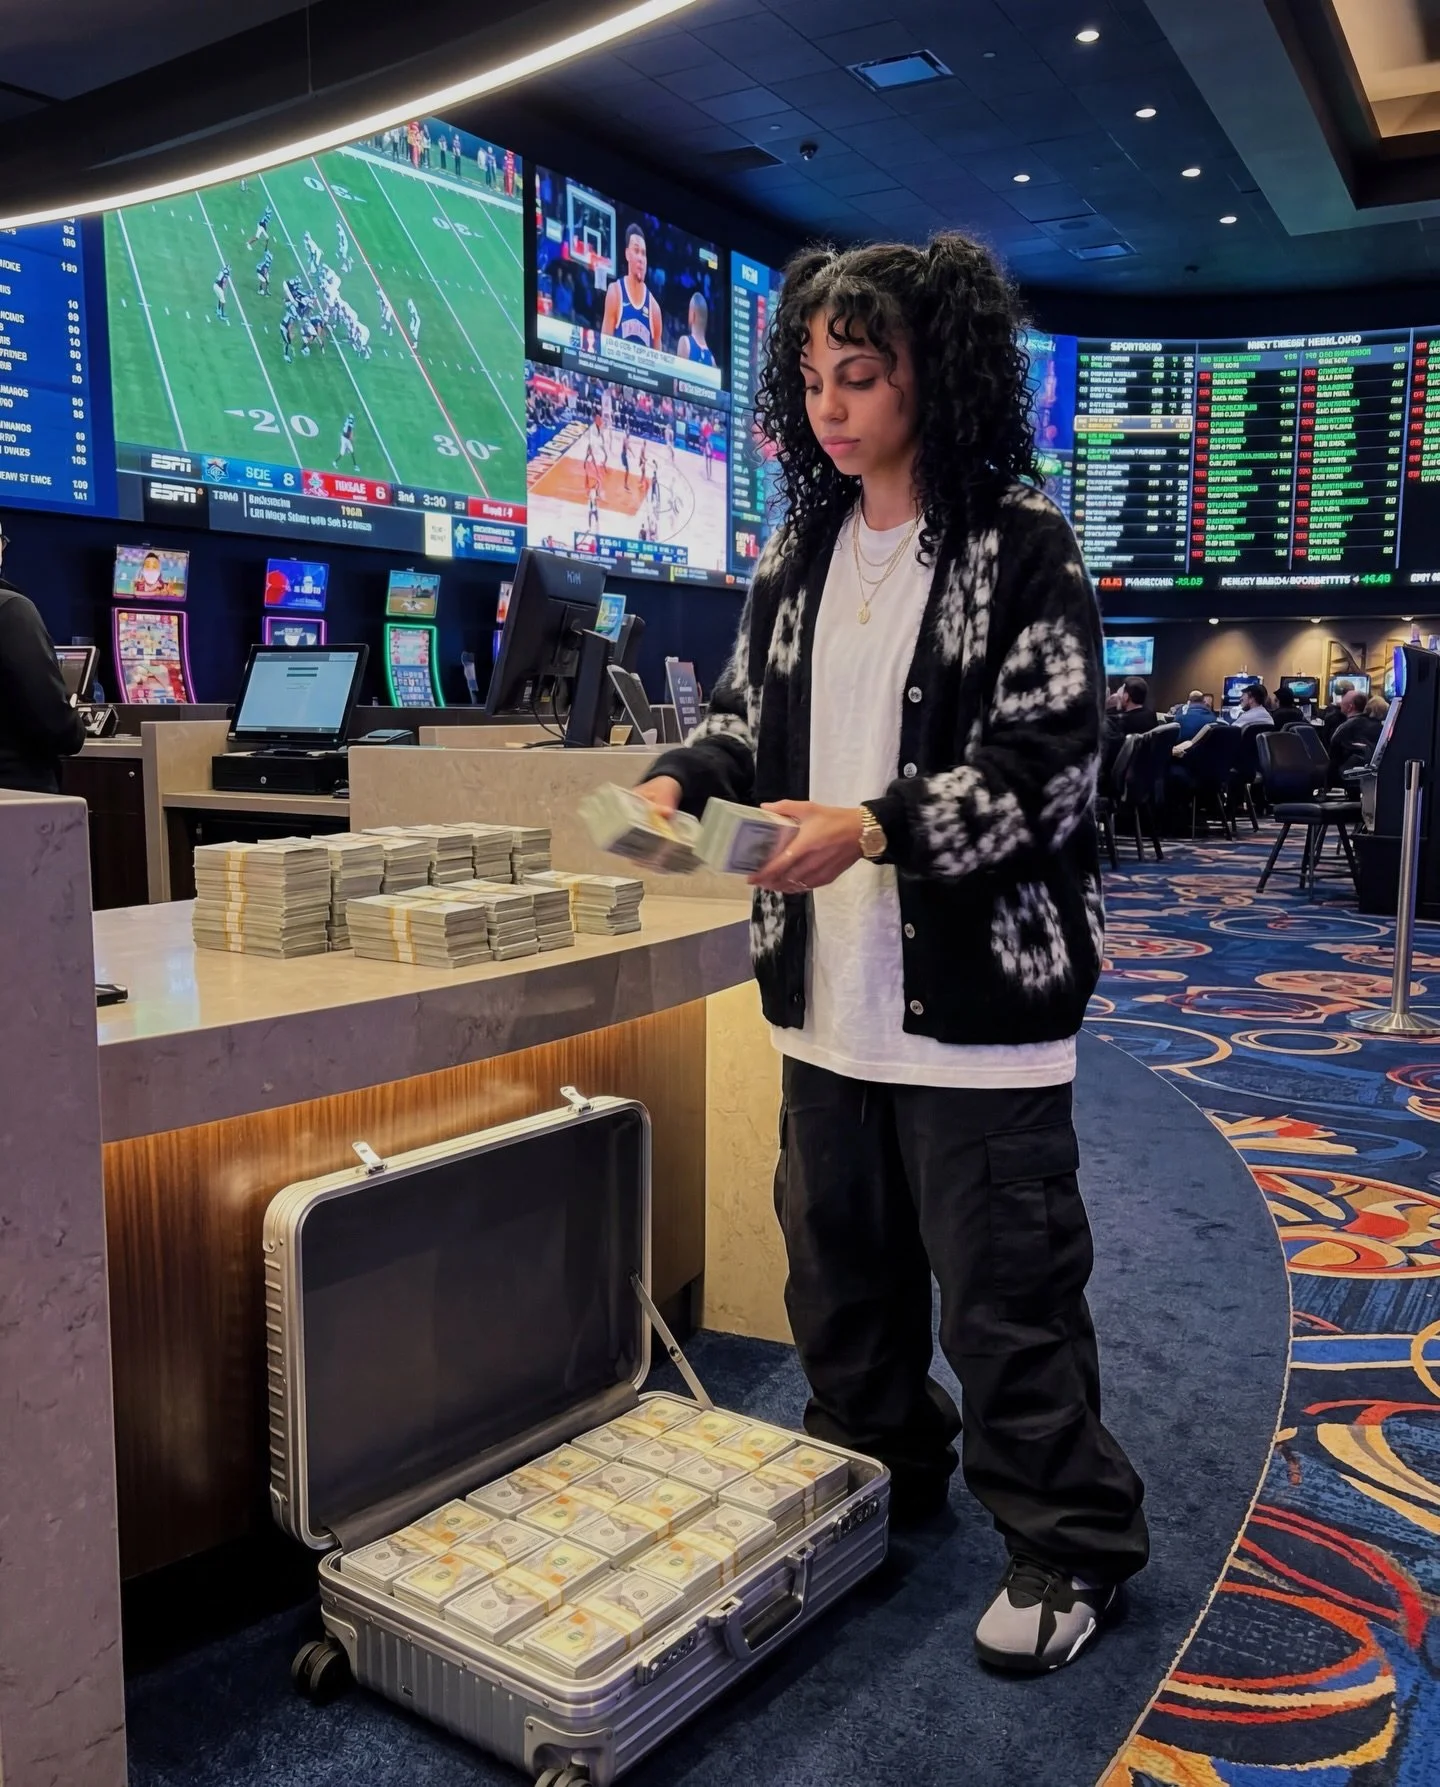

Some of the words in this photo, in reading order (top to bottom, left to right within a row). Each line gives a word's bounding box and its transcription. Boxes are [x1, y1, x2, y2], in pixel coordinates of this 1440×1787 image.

[248, 408, 319, 438] 20
[151, 453, 192, 473] ESPN
[283, 472, 295, 487] 8
[150, 482, 196, 503] ESPN
[375, 486, 386, 500] 6
